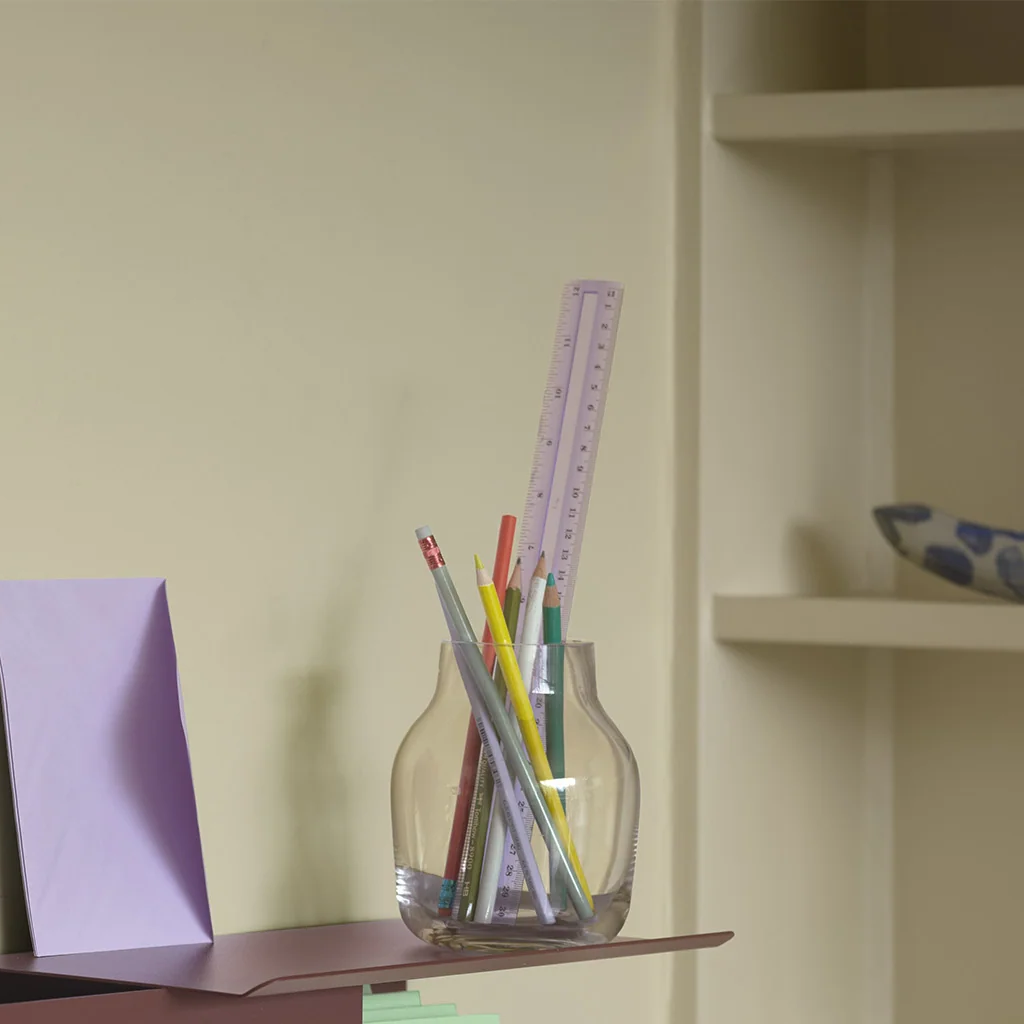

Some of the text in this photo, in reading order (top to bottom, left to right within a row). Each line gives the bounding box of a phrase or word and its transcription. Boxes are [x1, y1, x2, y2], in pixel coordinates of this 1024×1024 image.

[555, 388, 562, 399] 10
[564, 338, 571, 347] 11
[572, 287, 580, 296] 12
[572, 487, 580, 498] 10
[569, 508, 576, 518] 11
[565, 529, 573, 539] 12
[561, 549, 569, 560] 13
[558, 570, 566, 581] 14
[510, 843, 517, 856] 27
[505, 864, 514, 877] 28
[462, 881, 470, 897] HB
[501, 885, 510, 898] 29
[497, 905, 506, 917] 30
